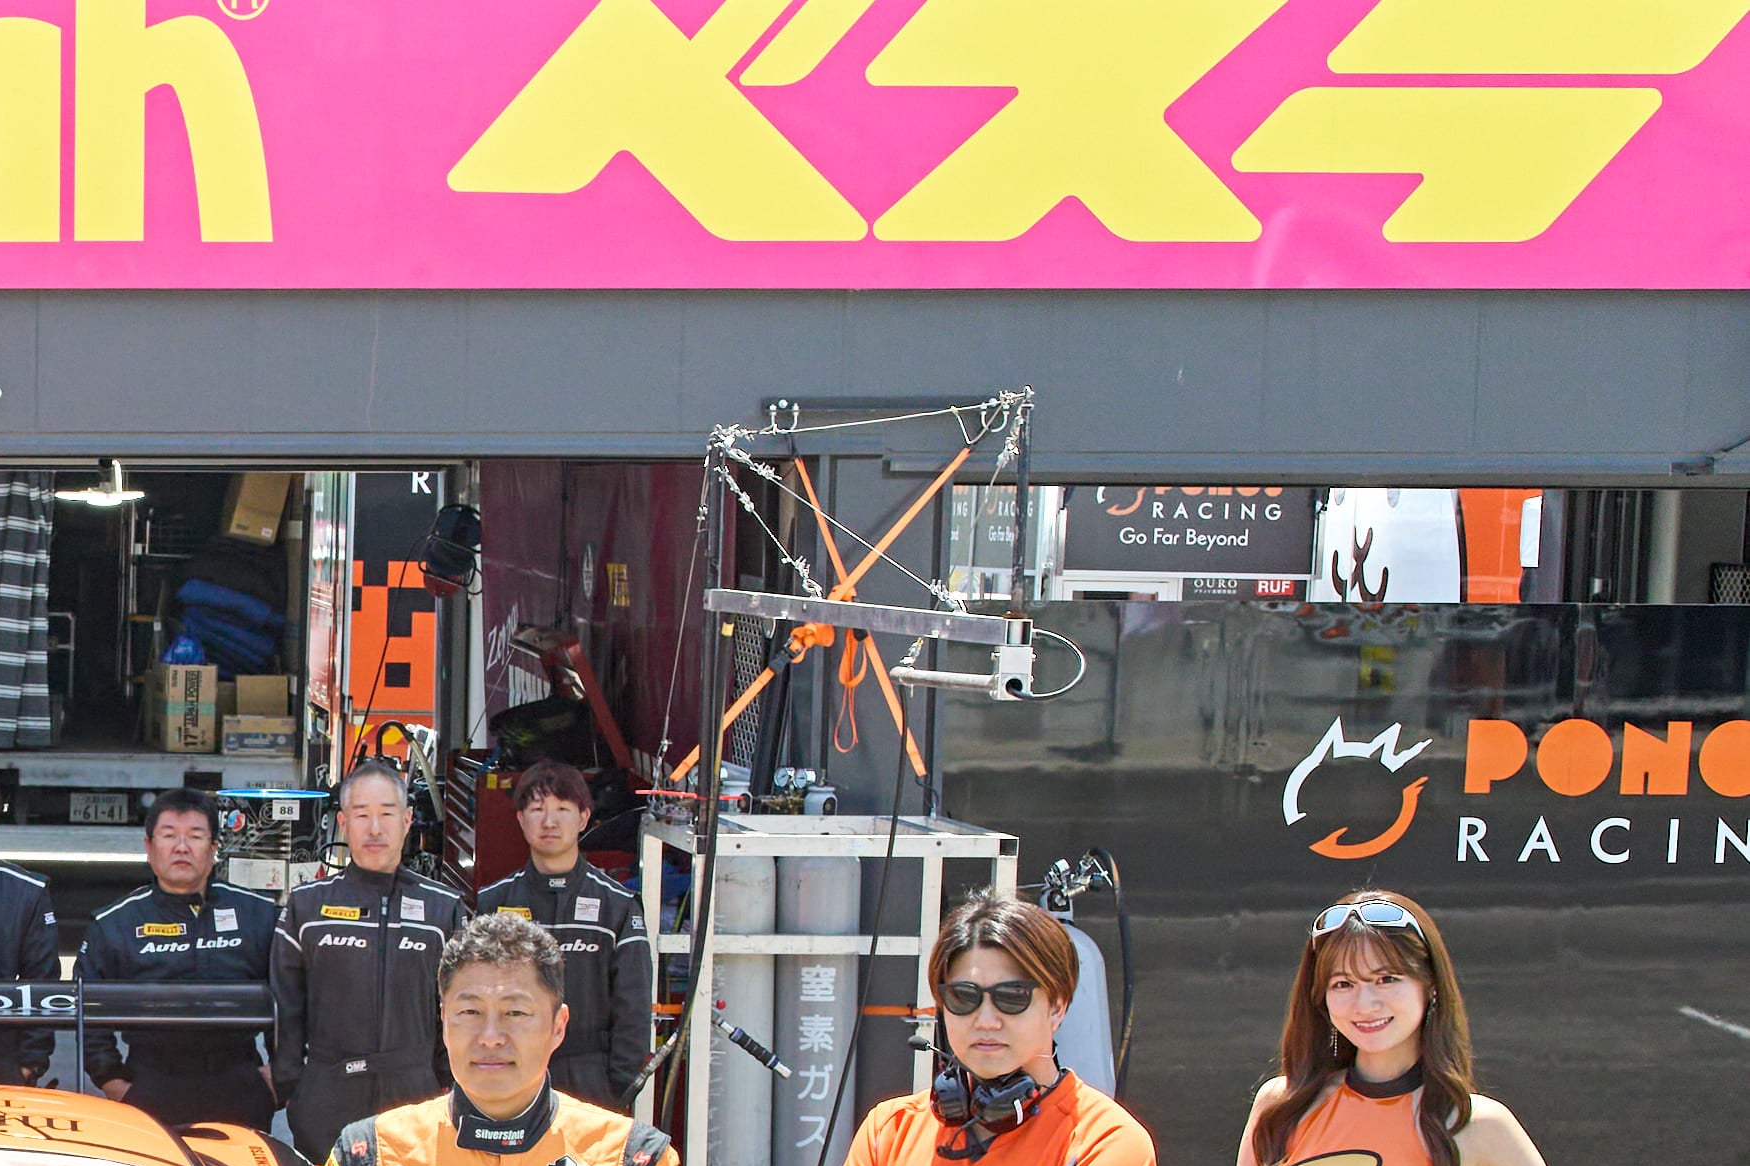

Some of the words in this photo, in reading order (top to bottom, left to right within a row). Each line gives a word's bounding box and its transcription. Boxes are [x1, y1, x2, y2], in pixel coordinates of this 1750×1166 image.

[1151, 502, 1283, 521] RACING
[1119, 527, 1148, 545] Go
[1153, 528, 1180, 546] Far
[1185, 528, 1249, 551] Beyond
[1193, 578, 1238, 589] OURO
[1257, 580, 1291, 594] RUF
[1464, 718, 1750, 798] PONO
[279, 806, 294, 816] 88
[1457, 818, 1750, 864] RACIN
[139, 941, 190, 954] Auto
[195, 936, 243, 950] Labo
[318, 933, 368, 948] Auto
[398, 936, 427, 951] bo
[559, 938, 600, 952] abo
[795, 964, 837, 1148] 窒素ガス
